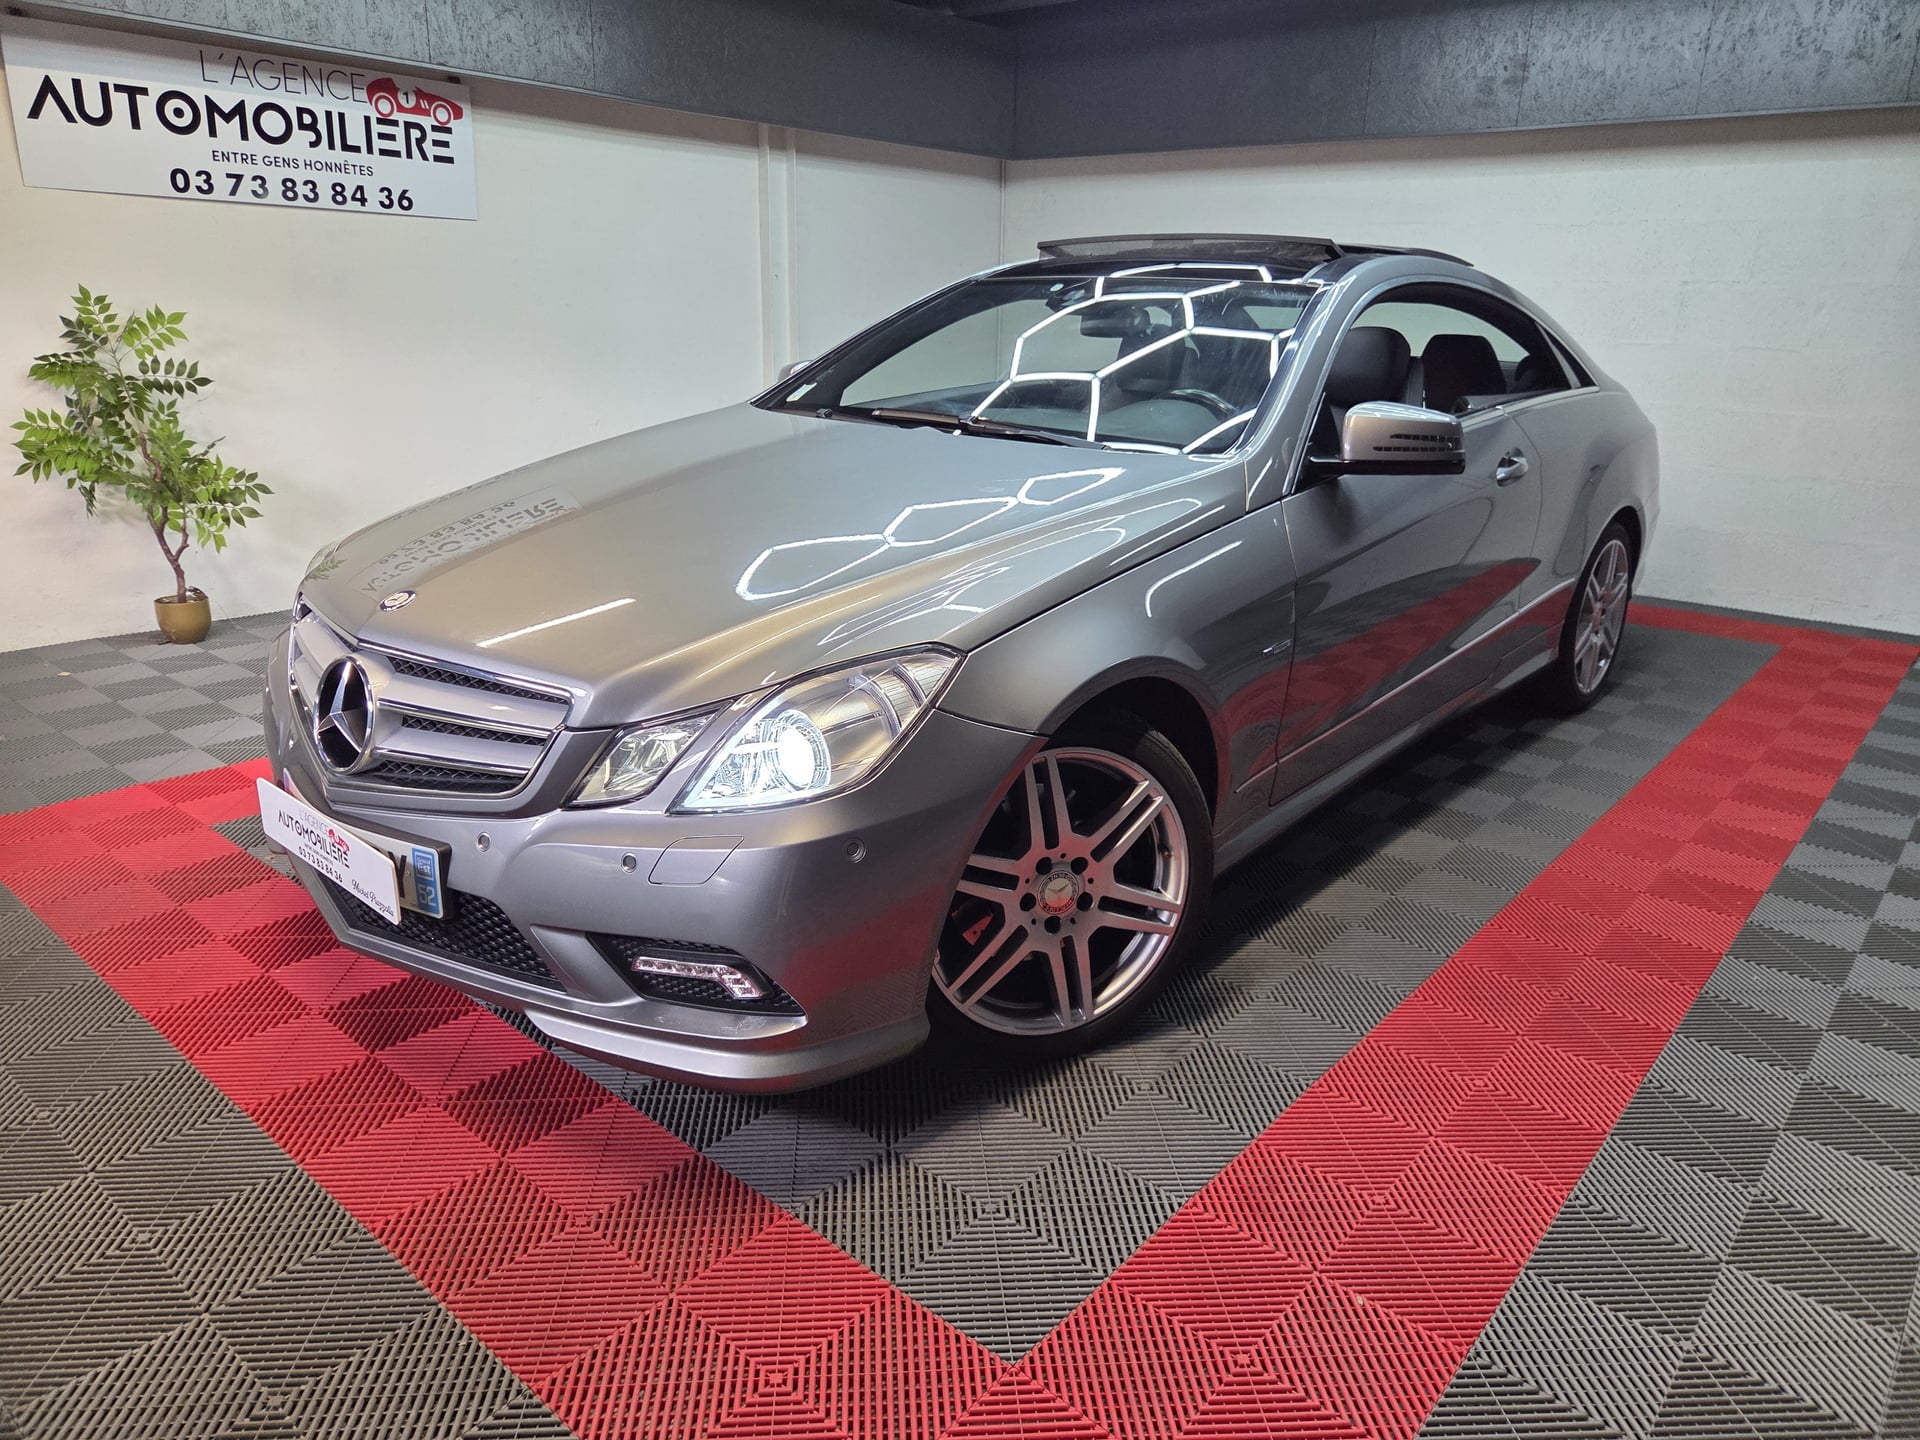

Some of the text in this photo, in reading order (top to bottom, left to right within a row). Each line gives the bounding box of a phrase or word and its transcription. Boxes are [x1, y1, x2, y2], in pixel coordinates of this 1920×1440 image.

[199, 49, 367, 104] L'AGENCE
[27, 74, 455, 164] AUTOMOBILIERE
[211, 150, 374, 177] ENTRE GENS HONNÊTES
[170, 167, 414, 211] 03 73 83 84 36
[278, 809, 350, 869] AUTOMOBILIERE
[418, 883, 436, 906] 52
